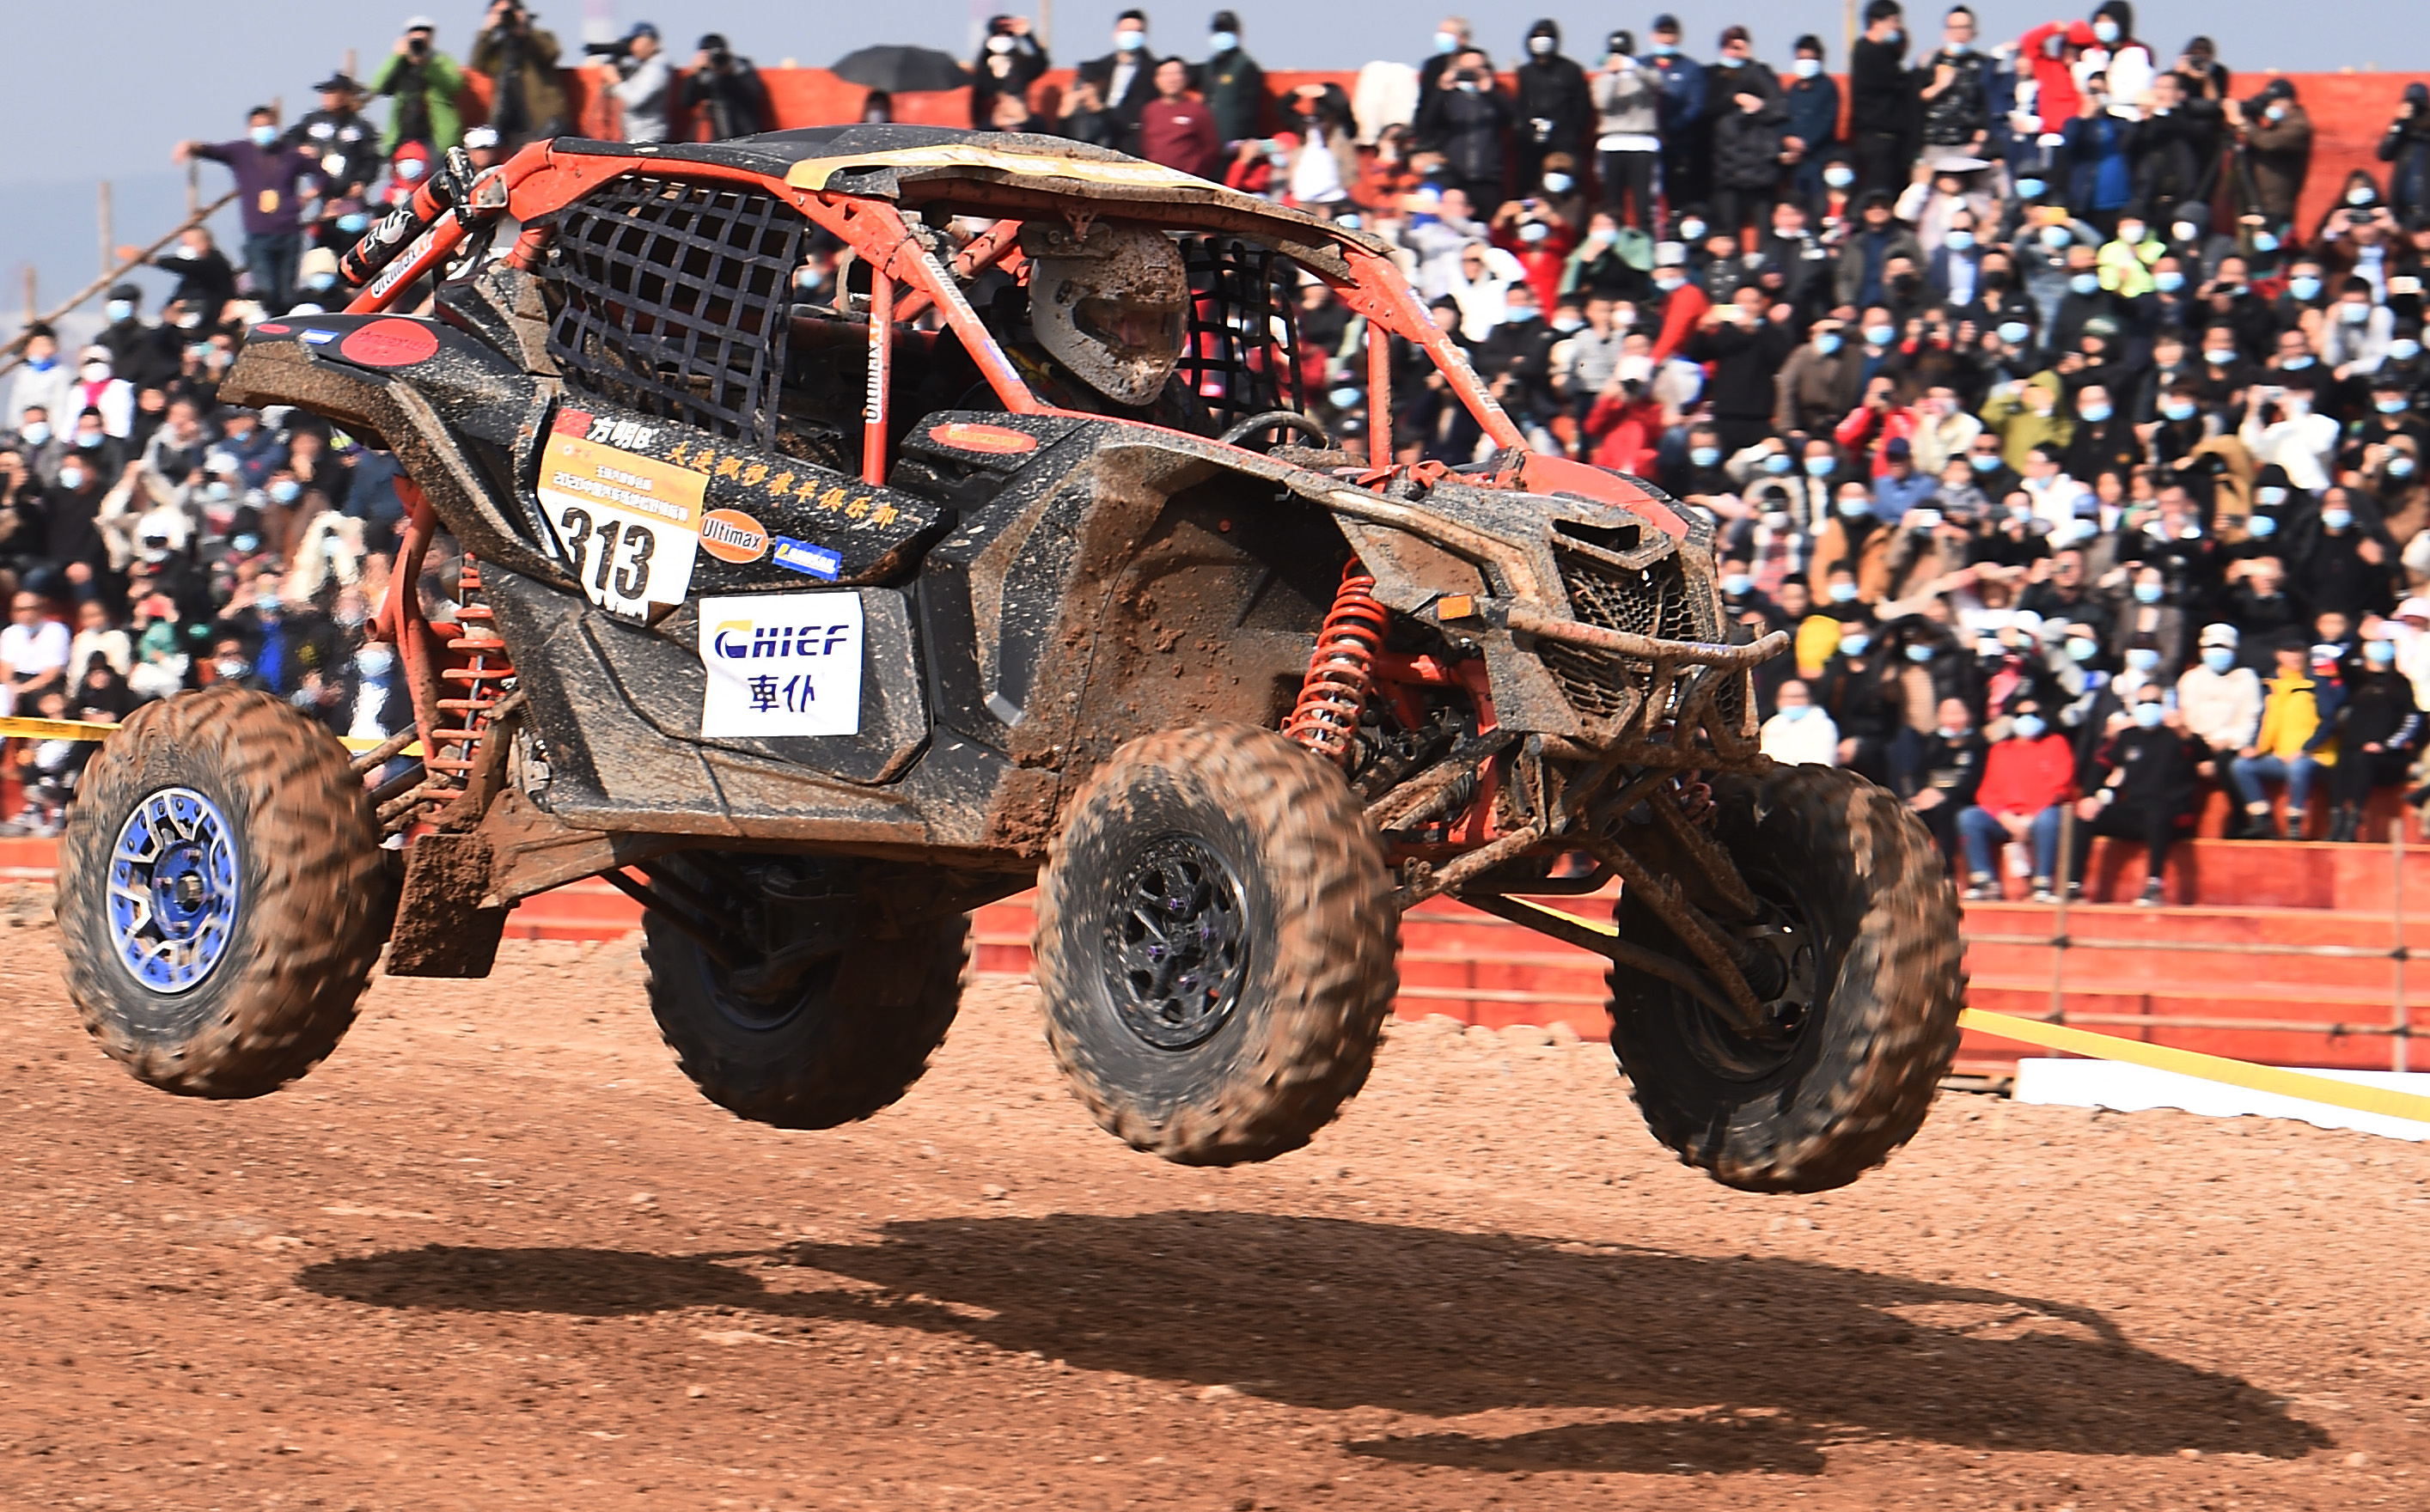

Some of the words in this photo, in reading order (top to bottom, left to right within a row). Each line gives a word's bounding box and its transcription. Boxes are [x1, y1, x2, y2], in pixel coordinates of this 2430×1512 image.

[561, 506, 655, 600] 313
[701, 518, 762, 550] Ultimax
[748, 674, 815, 713] 車仆
